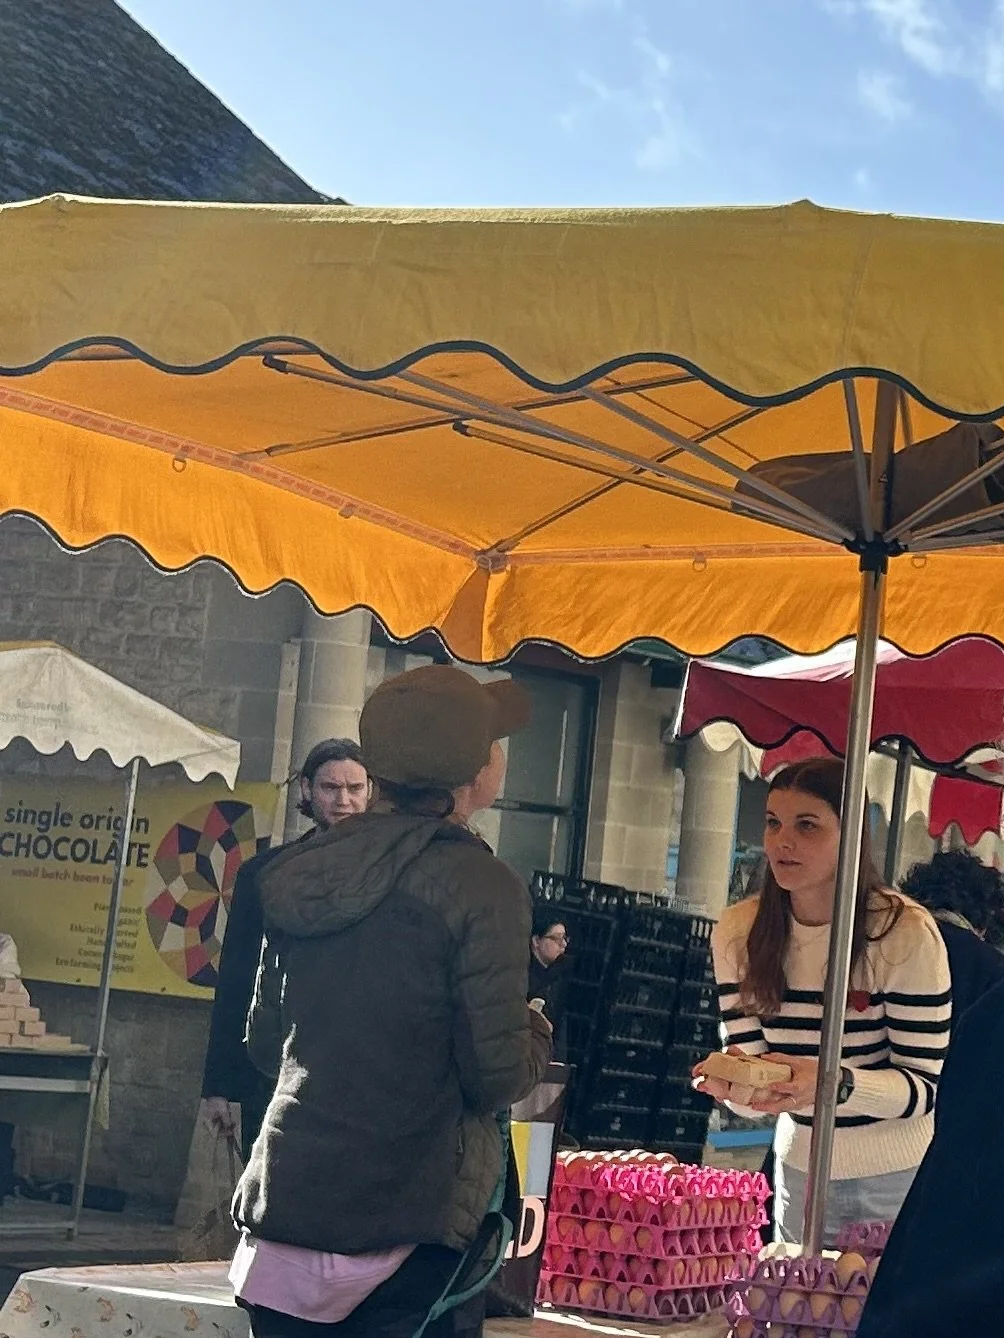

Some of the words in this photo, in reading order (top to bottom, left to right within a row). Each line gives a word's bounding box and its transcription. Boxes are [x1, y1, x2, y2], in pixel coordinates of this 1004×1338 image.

[5, 800, 74, 833] single
[80, 806, 150, 838] origin
[0, 832, 151, 868] CHOCOLATE
[11, 866, 39, 878] small
[41, 868, 71, 881] batch
[73, 871, 101, 884] bean
